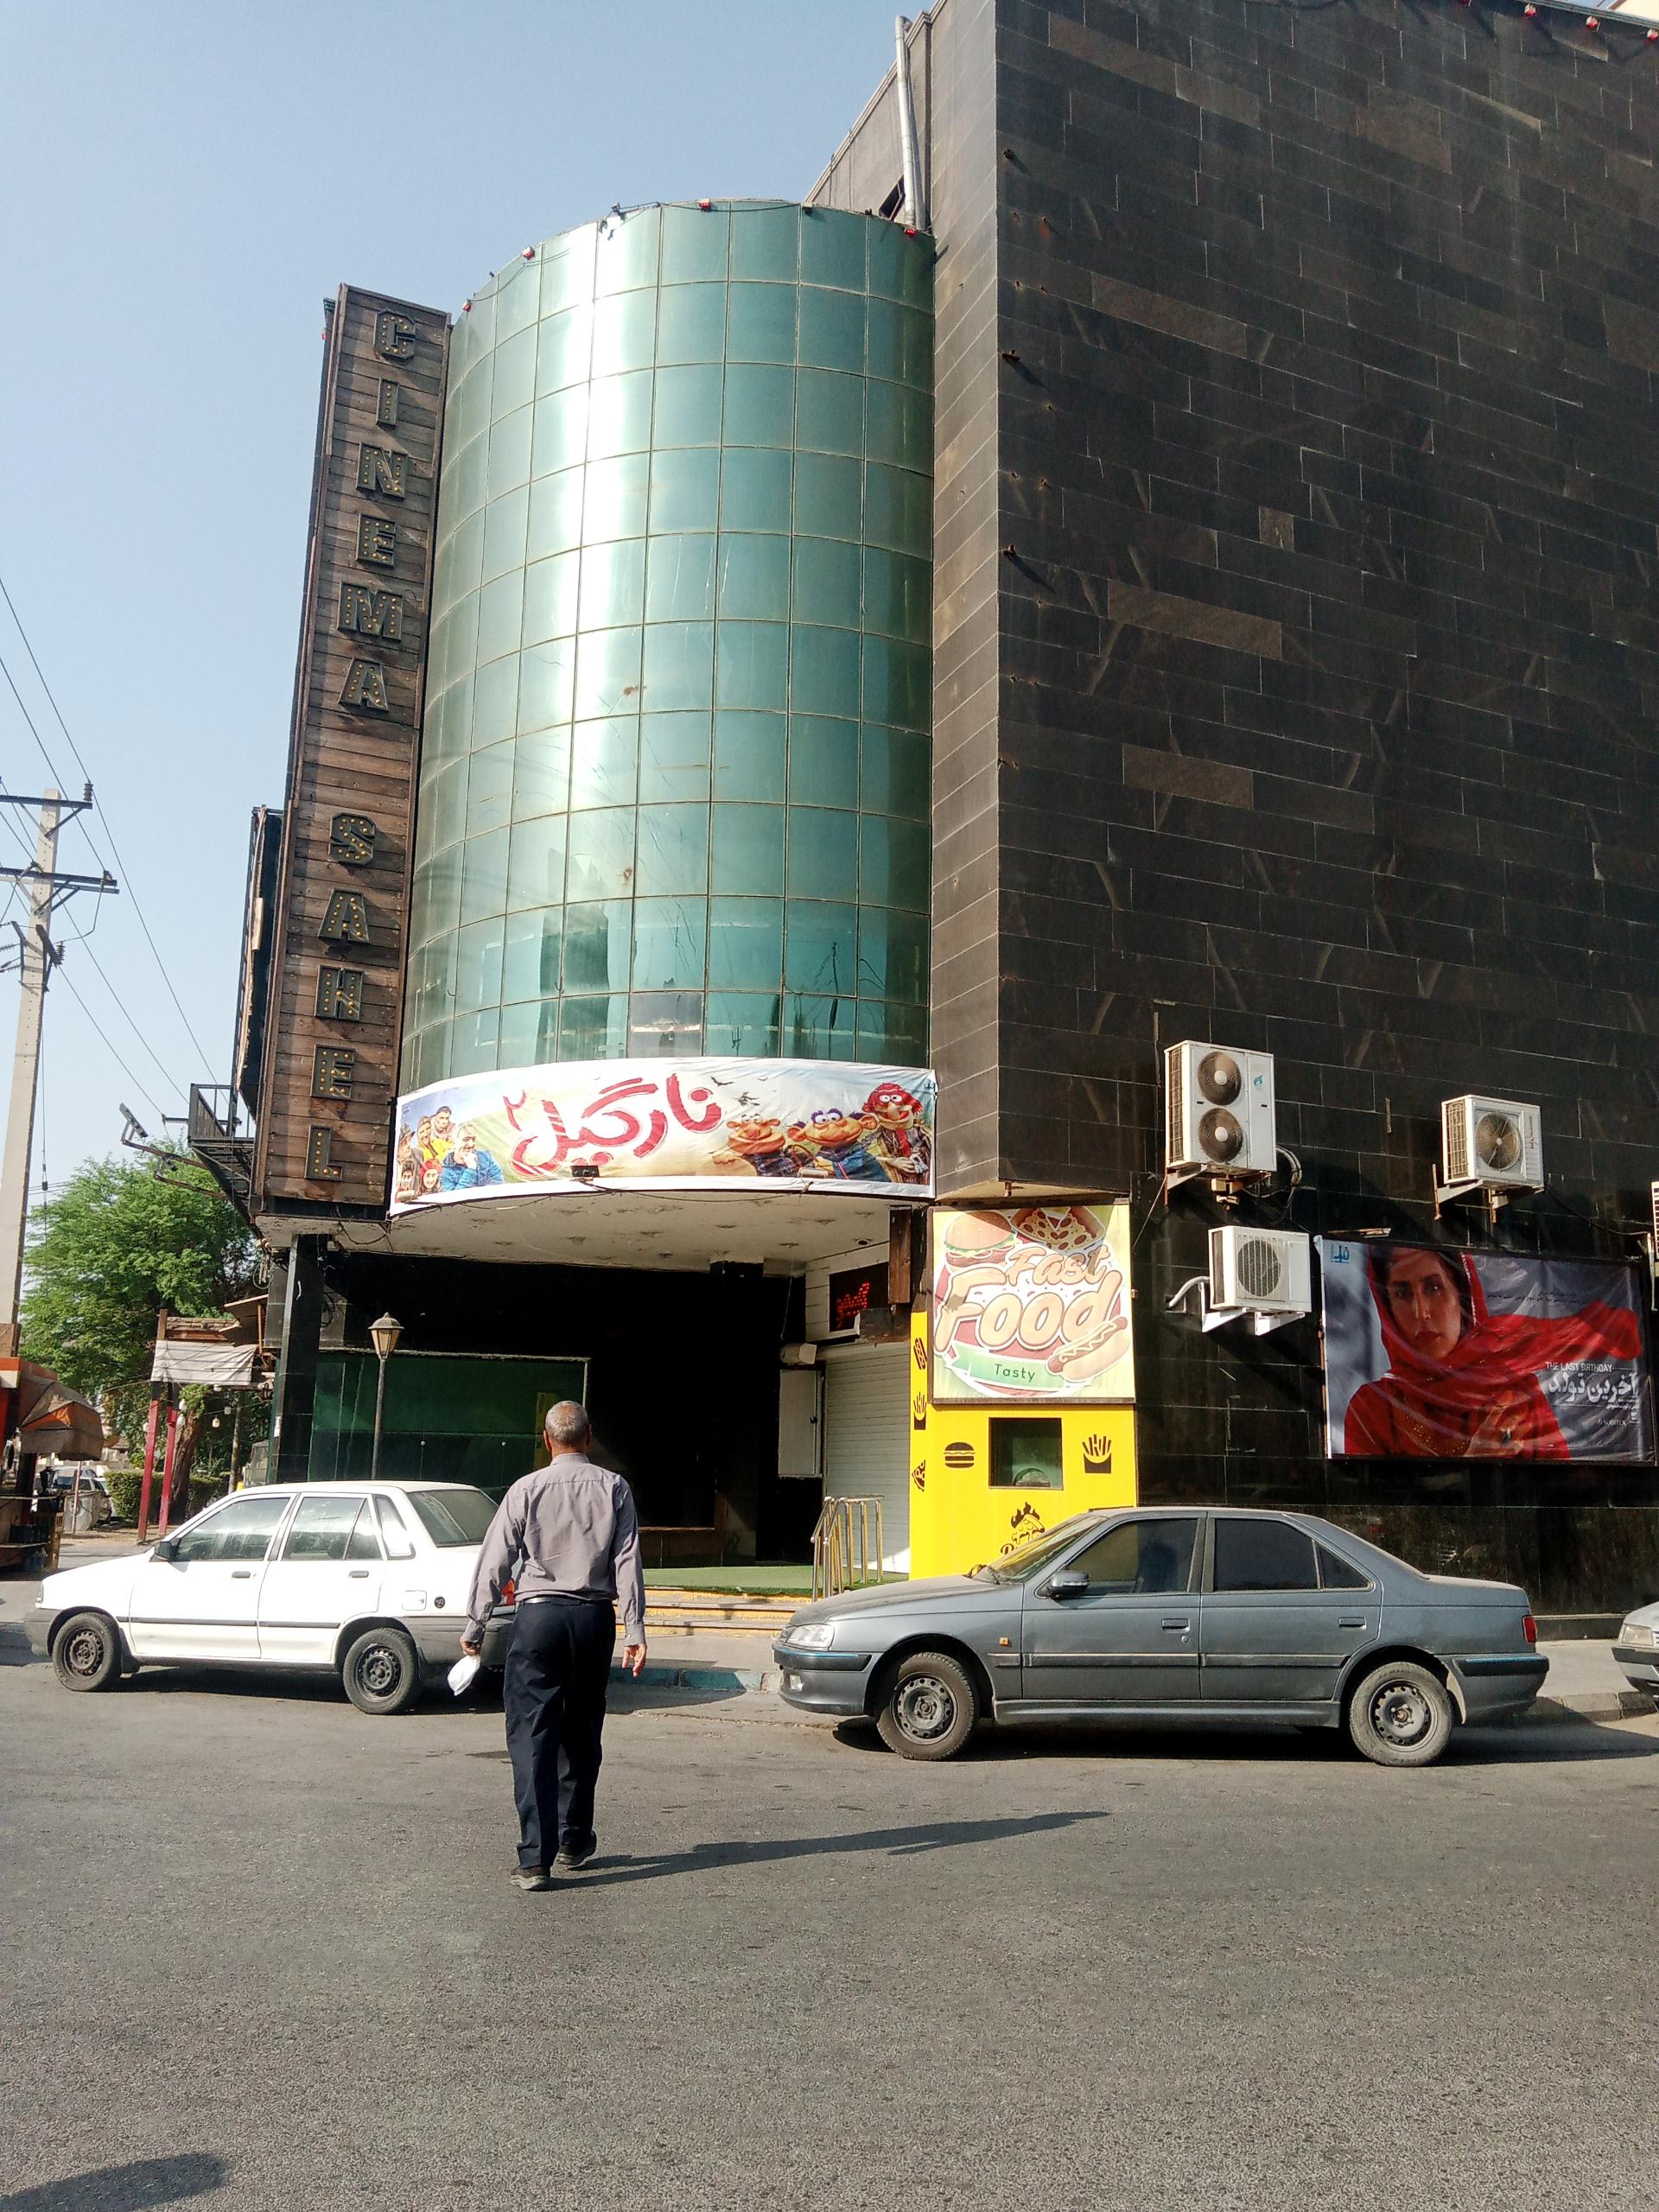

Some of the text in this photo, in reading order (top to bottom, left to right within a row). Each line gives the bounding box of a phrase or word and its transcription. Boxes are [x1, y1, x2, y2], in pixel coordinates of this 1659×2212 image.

[337, 309, 416, 712] CINEMA
[304, 810, 377, 1181] SAHEL
[510, 1073, 721, 1178] نارگیل
[1006, 1245, 1110, 1287] Fast
[934, 1267, 1122, 1352] Food
[995, 1363, 1036, 1382] Tasty
[1545, 1362, 1613, 1373] THE LAST BIRTHDAY
[1548, 1371, 1637, 1403] آخرین تولد
